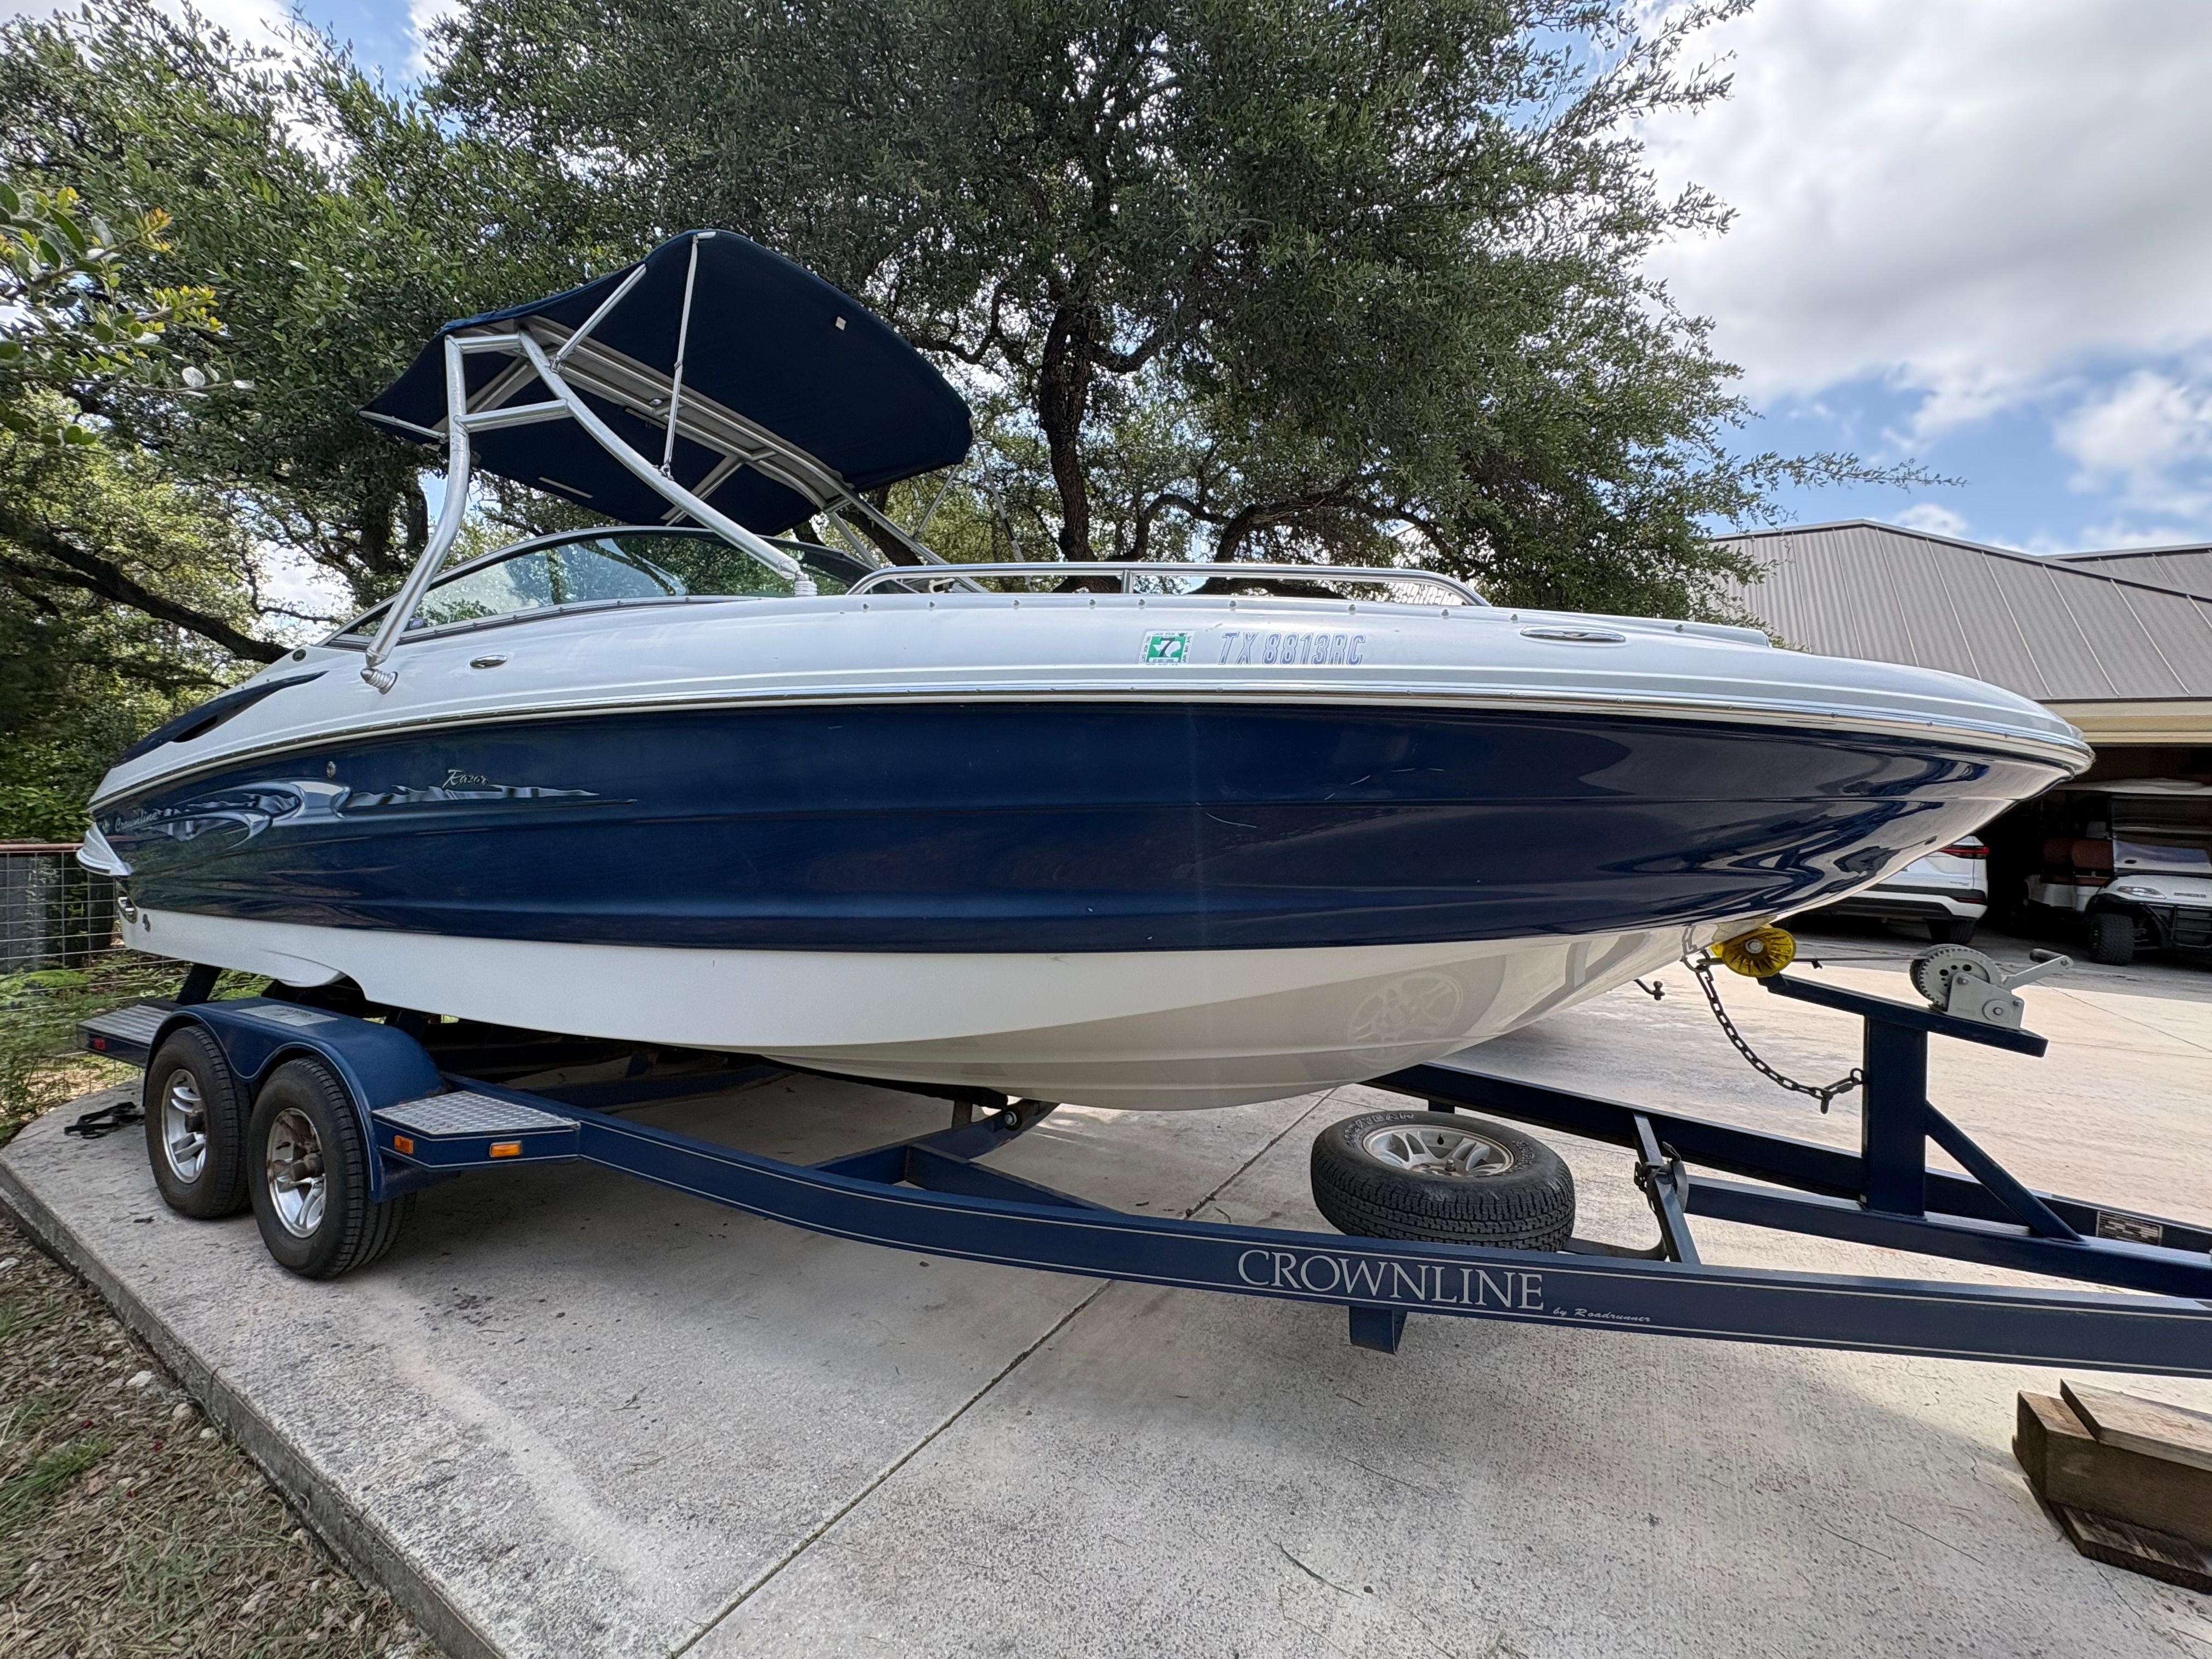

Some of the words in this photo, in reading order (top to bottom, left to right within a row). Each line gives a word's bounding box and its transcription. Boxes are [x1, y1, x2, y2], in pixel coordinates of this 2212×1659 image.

[1159, 637, 1176, 657] 7
[1218, 631, 1259, 665] TX
[1262, 633, 1366, 665] 8813RC
[442, 769, 487, 788] Razor
[115, 808, 158, 832] Crownline
[1238, 1249, 1544, 1311] CROWNLINE
[1553, 1307, 1567, 1317] by
[1574, 1308, 1651, 1322] Roadrunner
